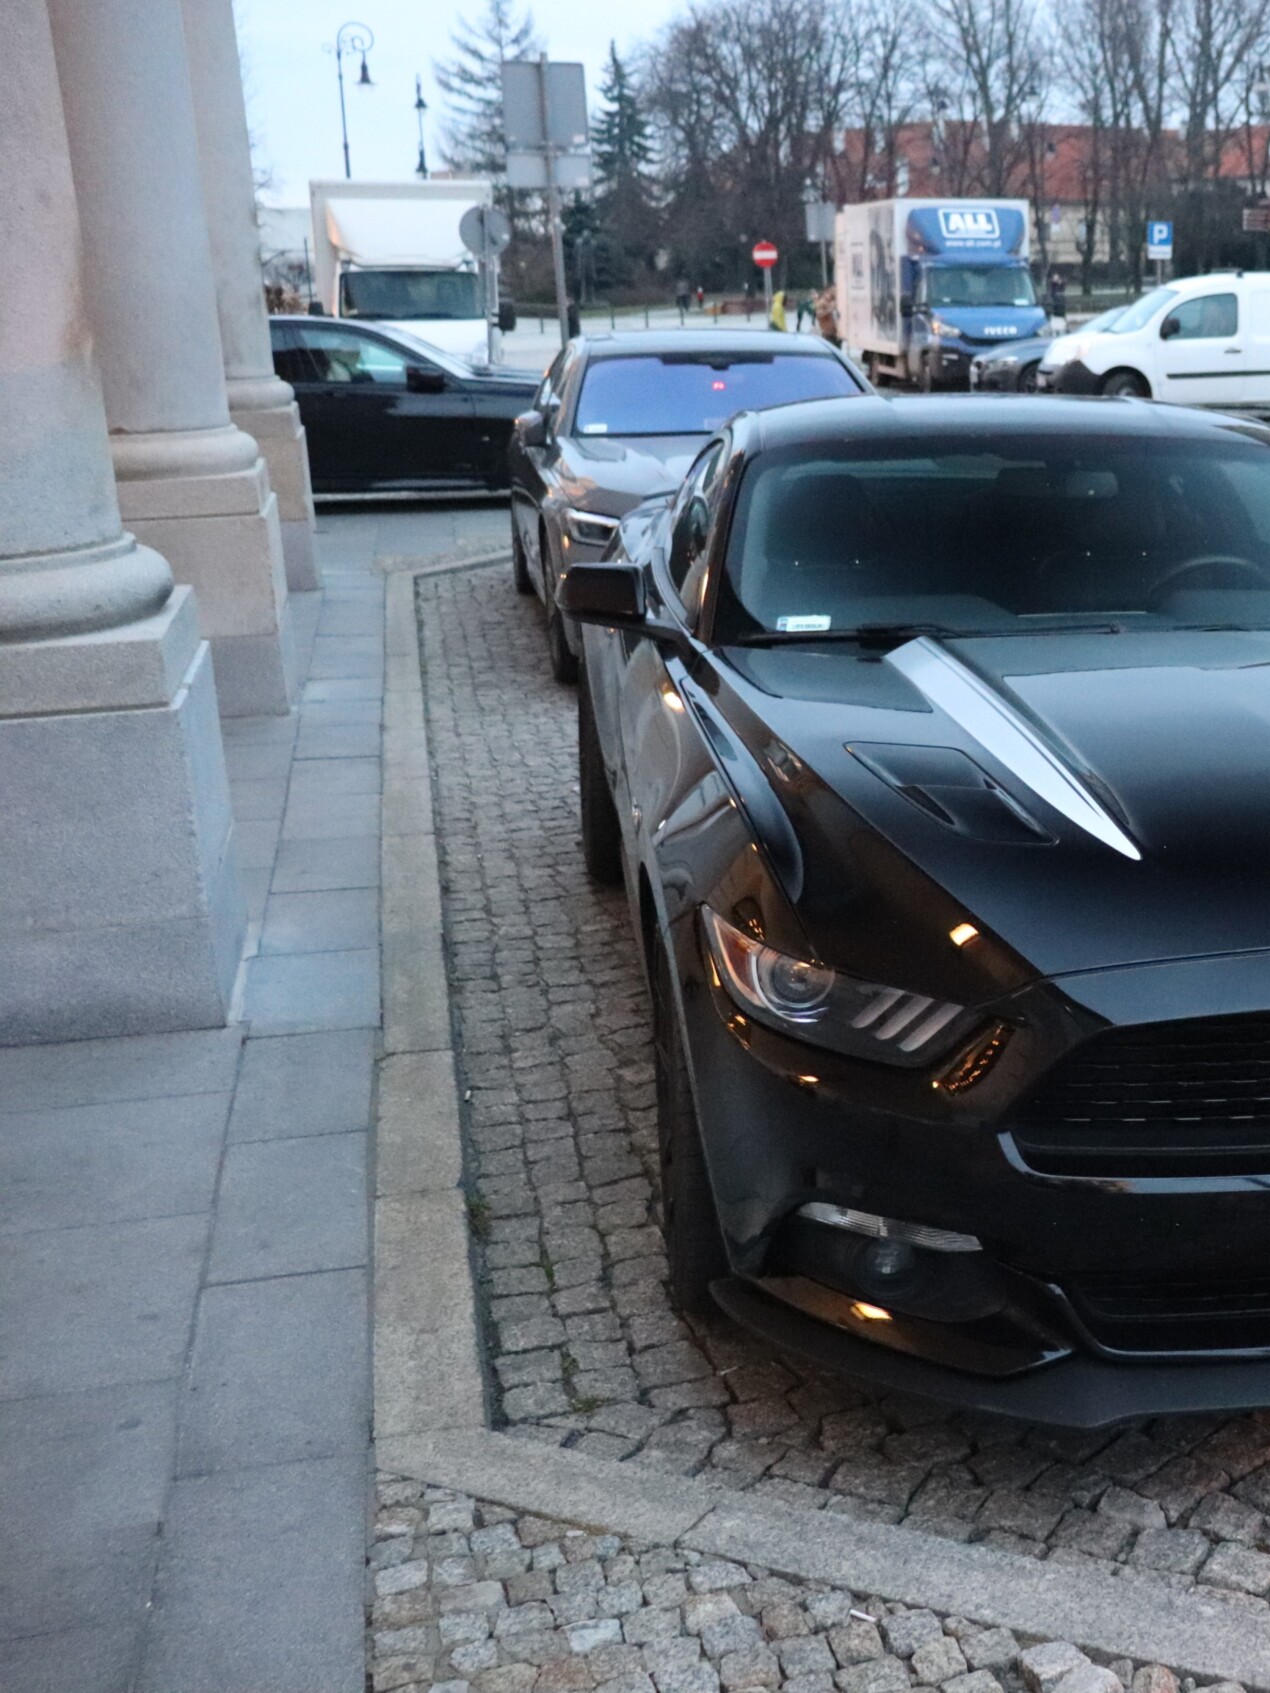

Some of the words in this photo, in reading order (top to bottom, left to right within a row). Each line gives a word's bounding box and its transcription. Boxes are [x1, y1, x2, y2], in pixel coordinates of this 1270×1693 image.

[948, 212, 994, 232] ALL
[1153, 223, 1169, 245] P
[984, 325, 1018, 336] IVECO
